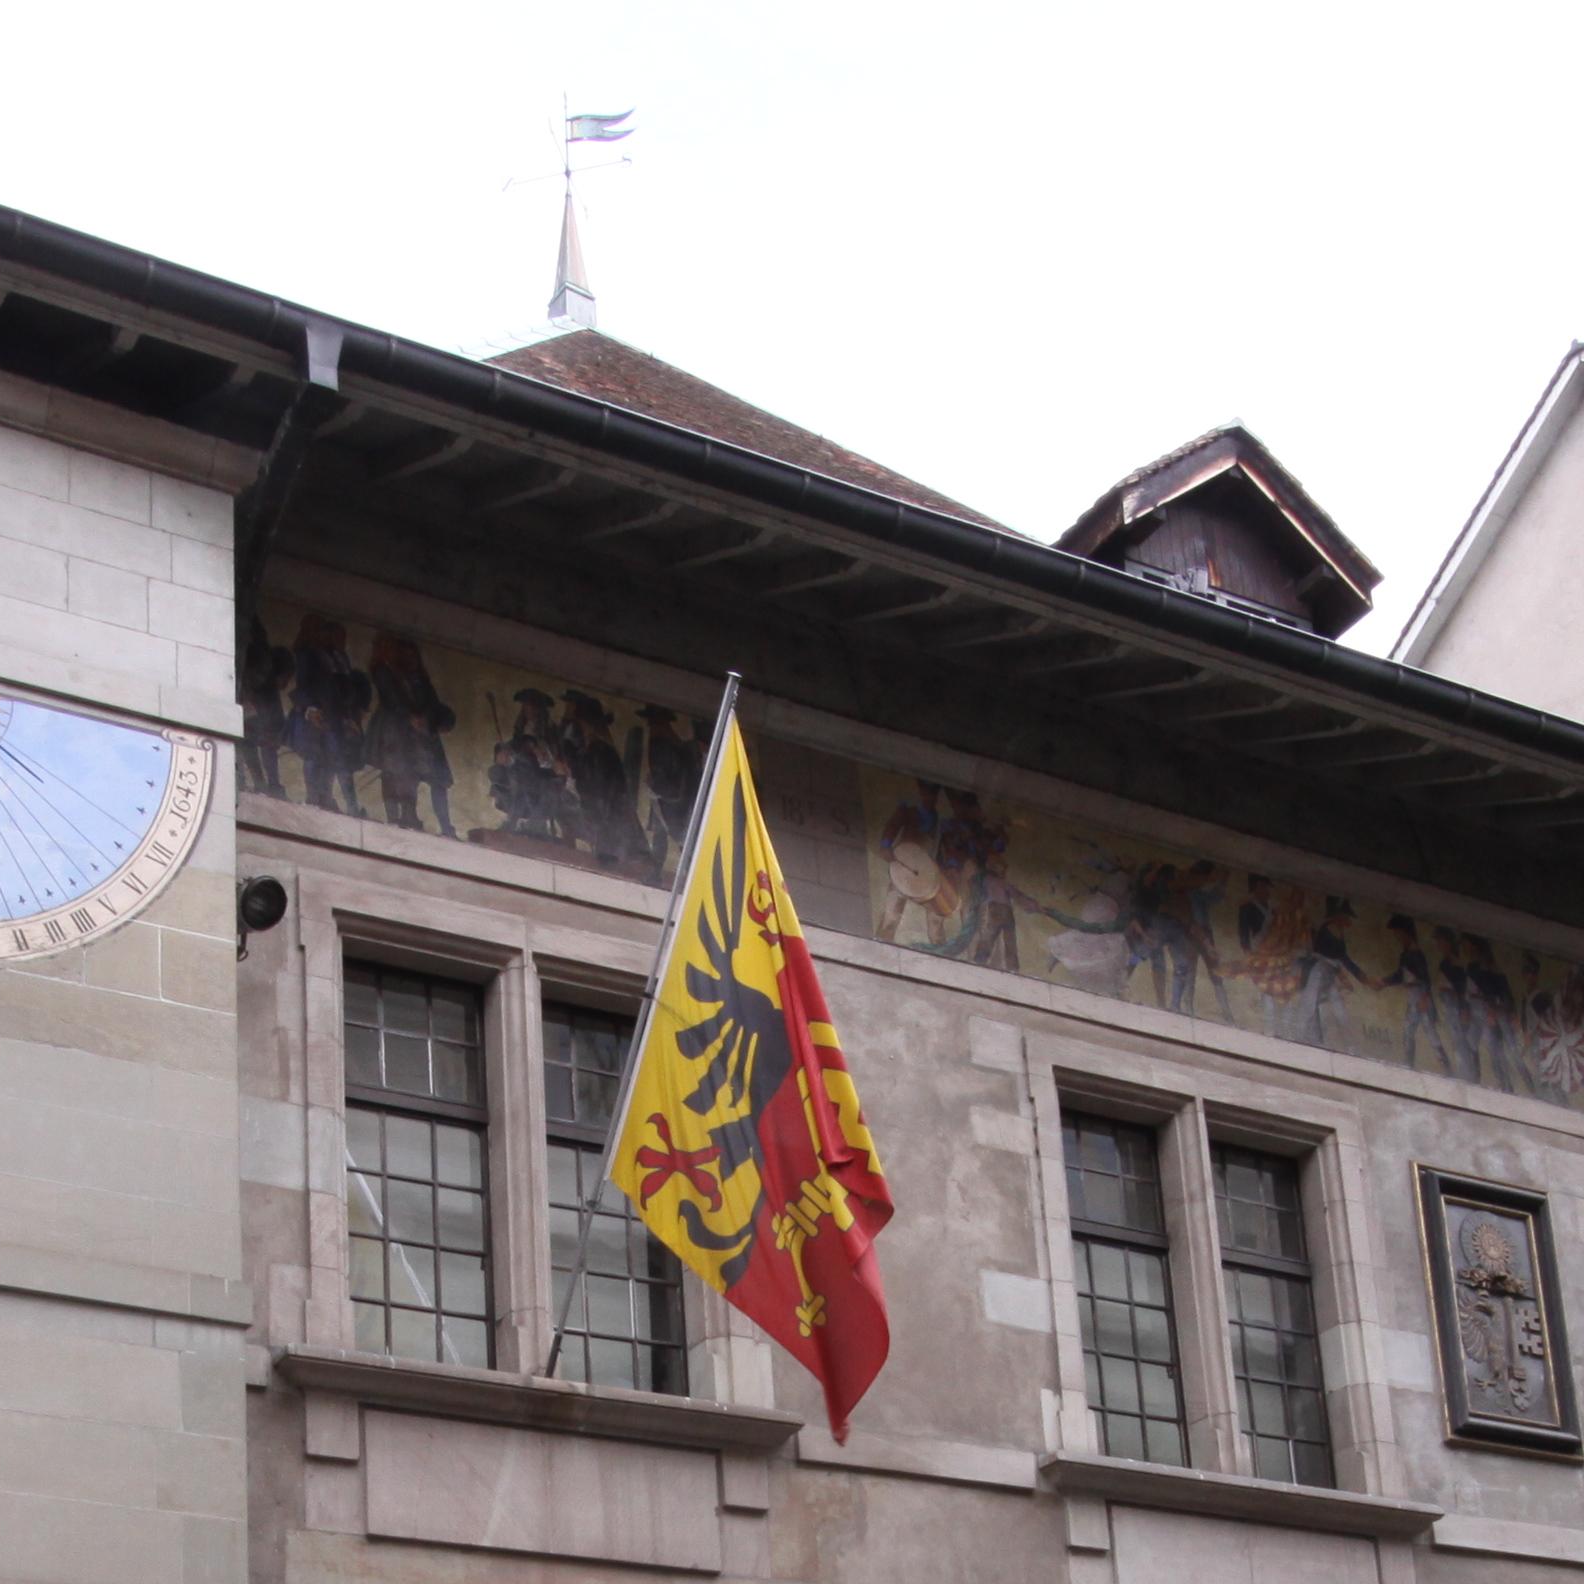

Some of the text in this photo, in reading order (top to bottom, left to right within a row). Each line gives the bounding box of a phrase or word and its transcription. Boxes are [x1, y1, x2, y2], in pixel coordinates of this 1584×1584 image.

[170, 771, 198, 830] 1643
[43, 919, 67, 944] III
[69, 907, 97, 934] IIII
[97, 893, 117, 916] V
[121, 871, 148, 895] VI
[145, 840, 175, 867] VII
